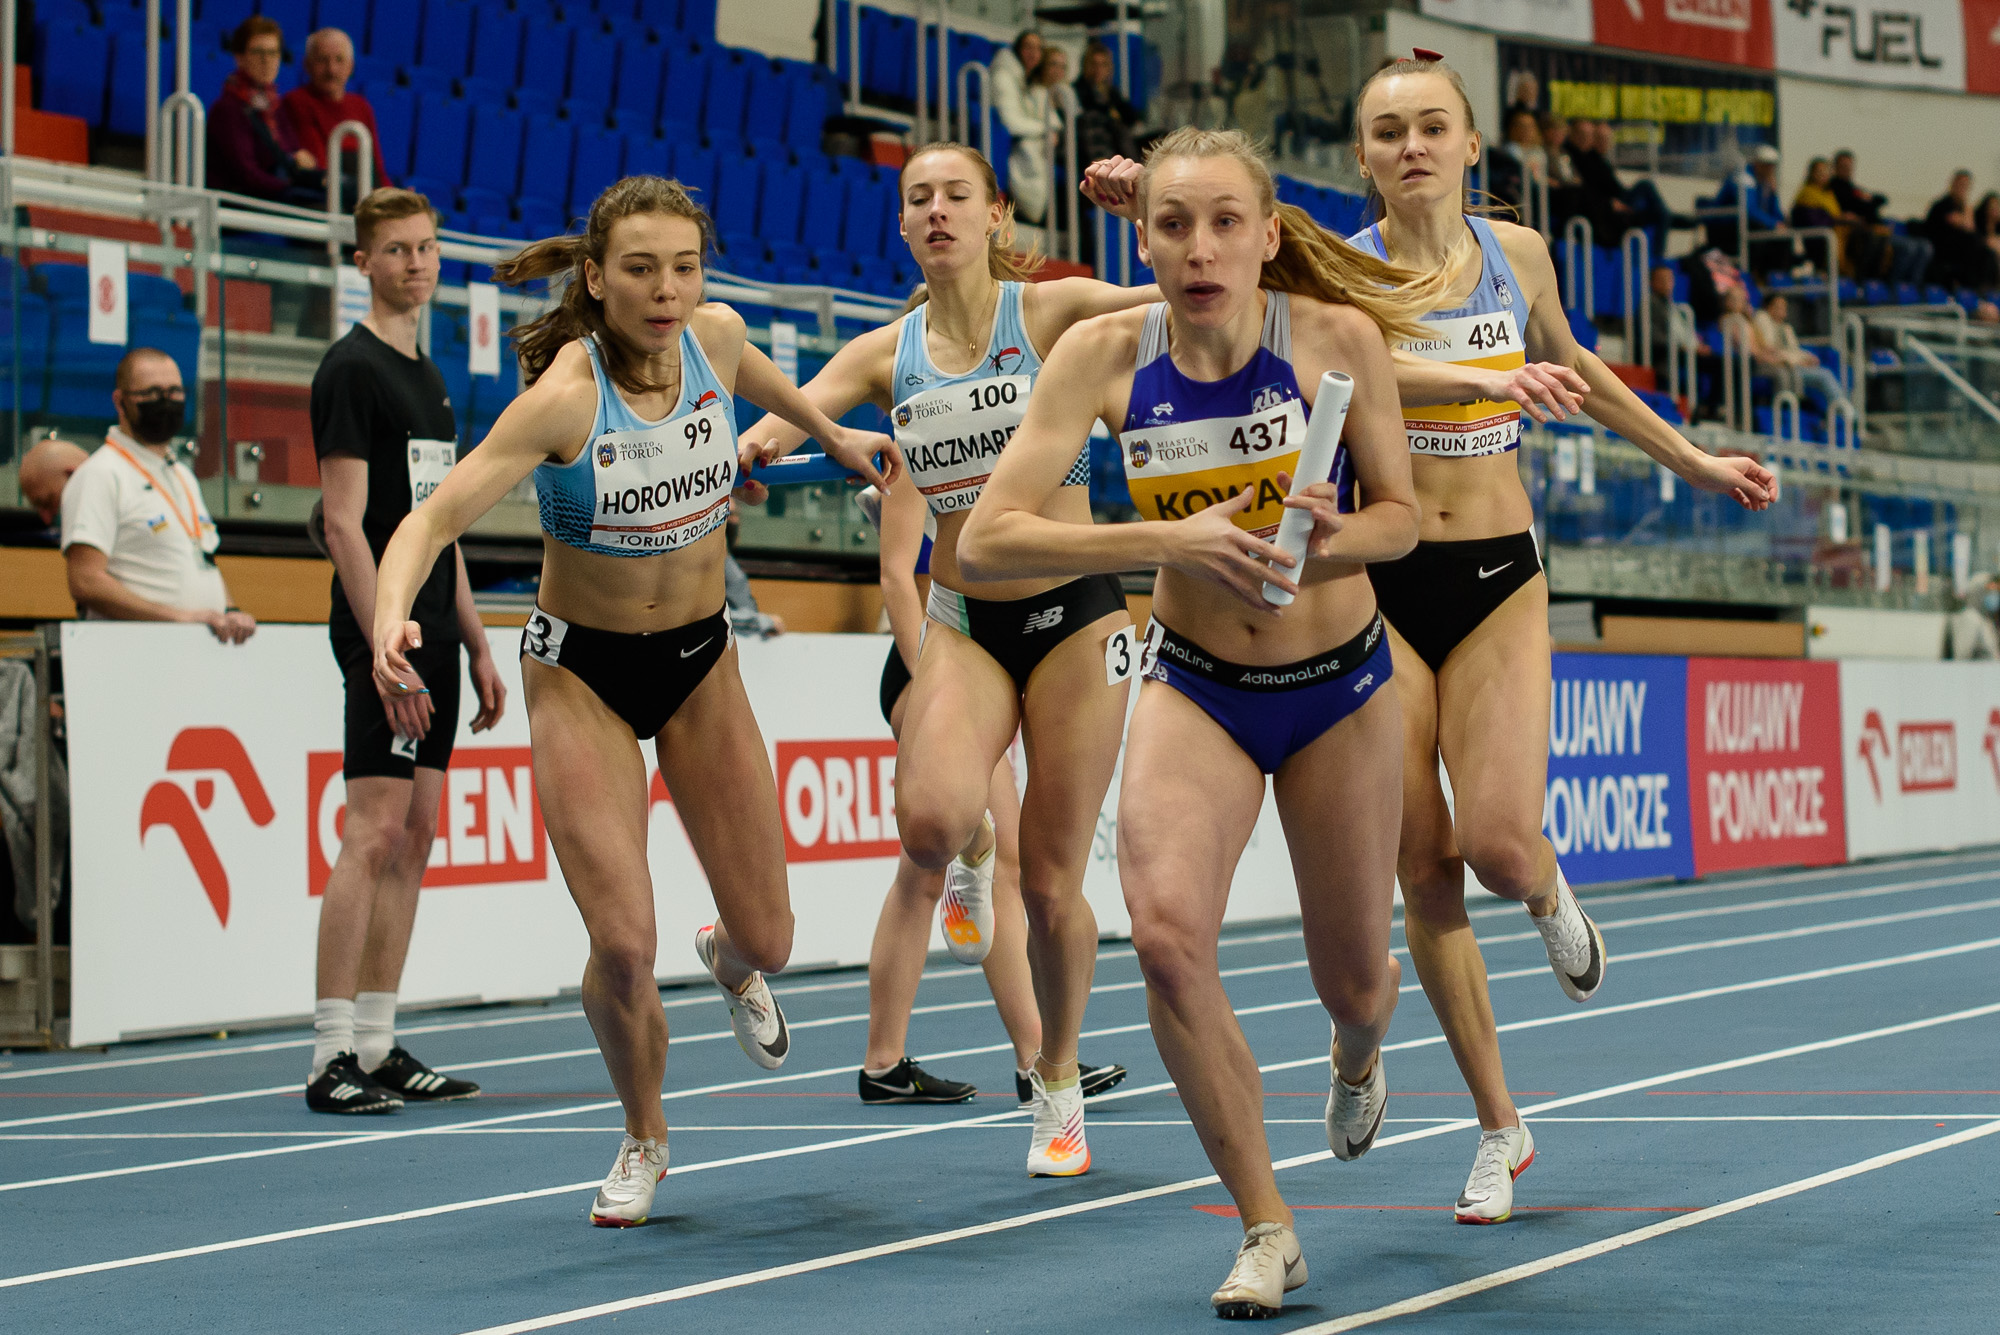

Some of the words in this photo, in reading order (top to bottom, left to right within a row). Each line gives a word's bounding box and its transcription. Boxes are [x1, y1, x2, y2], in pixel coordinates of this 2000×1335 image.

[1822, 5, 1943, 68] FUEL
[1468, 320, 1510, 350] 434
[915, 399, 944, 409] MIASTO
[915, 401, 953, 420] TORUŃ
[969, 382, 1017, 412] 100
[620, 441, 655, 450] MIASTO
[620, 443, 663, 461] TORUŃ
[684, 418, 712, 450] 99
[904, 424, 1020, 474] KACZMAR
[1156, 439, 1208, 462] TORUŃ
[1157, 437, 1196, 448] MIASTO
[1229, 414, 1288, 455] 437
[1408, 434, 1466, 452] TORUŃ
[1471, 430, 1502, 450] 2022
[602, 460, 731, 515] HOROWSKA
[1154, 478, 1285, 522] KOWA
[619, 530, 677, 547] TORUŃ
[682, 517, 711, 542] 2022
[527, 614, 552, 658] 3
[1112, 633, 1130, 677] 3
[1161, 638, 1214, 672] naLine
[1239, 659, 1341, 685] AdRunaLine
[1549, 680, 1647, 757] UJAWY
[1705, 681, 1804, 753] KUJAWY
[318, 765, 534, 868] OEN
[785, 755, 898, 848] ORLE
[1543, 773, 1672, 857] OMORZE
[1707, 766, 1828, 843] POMORZE
